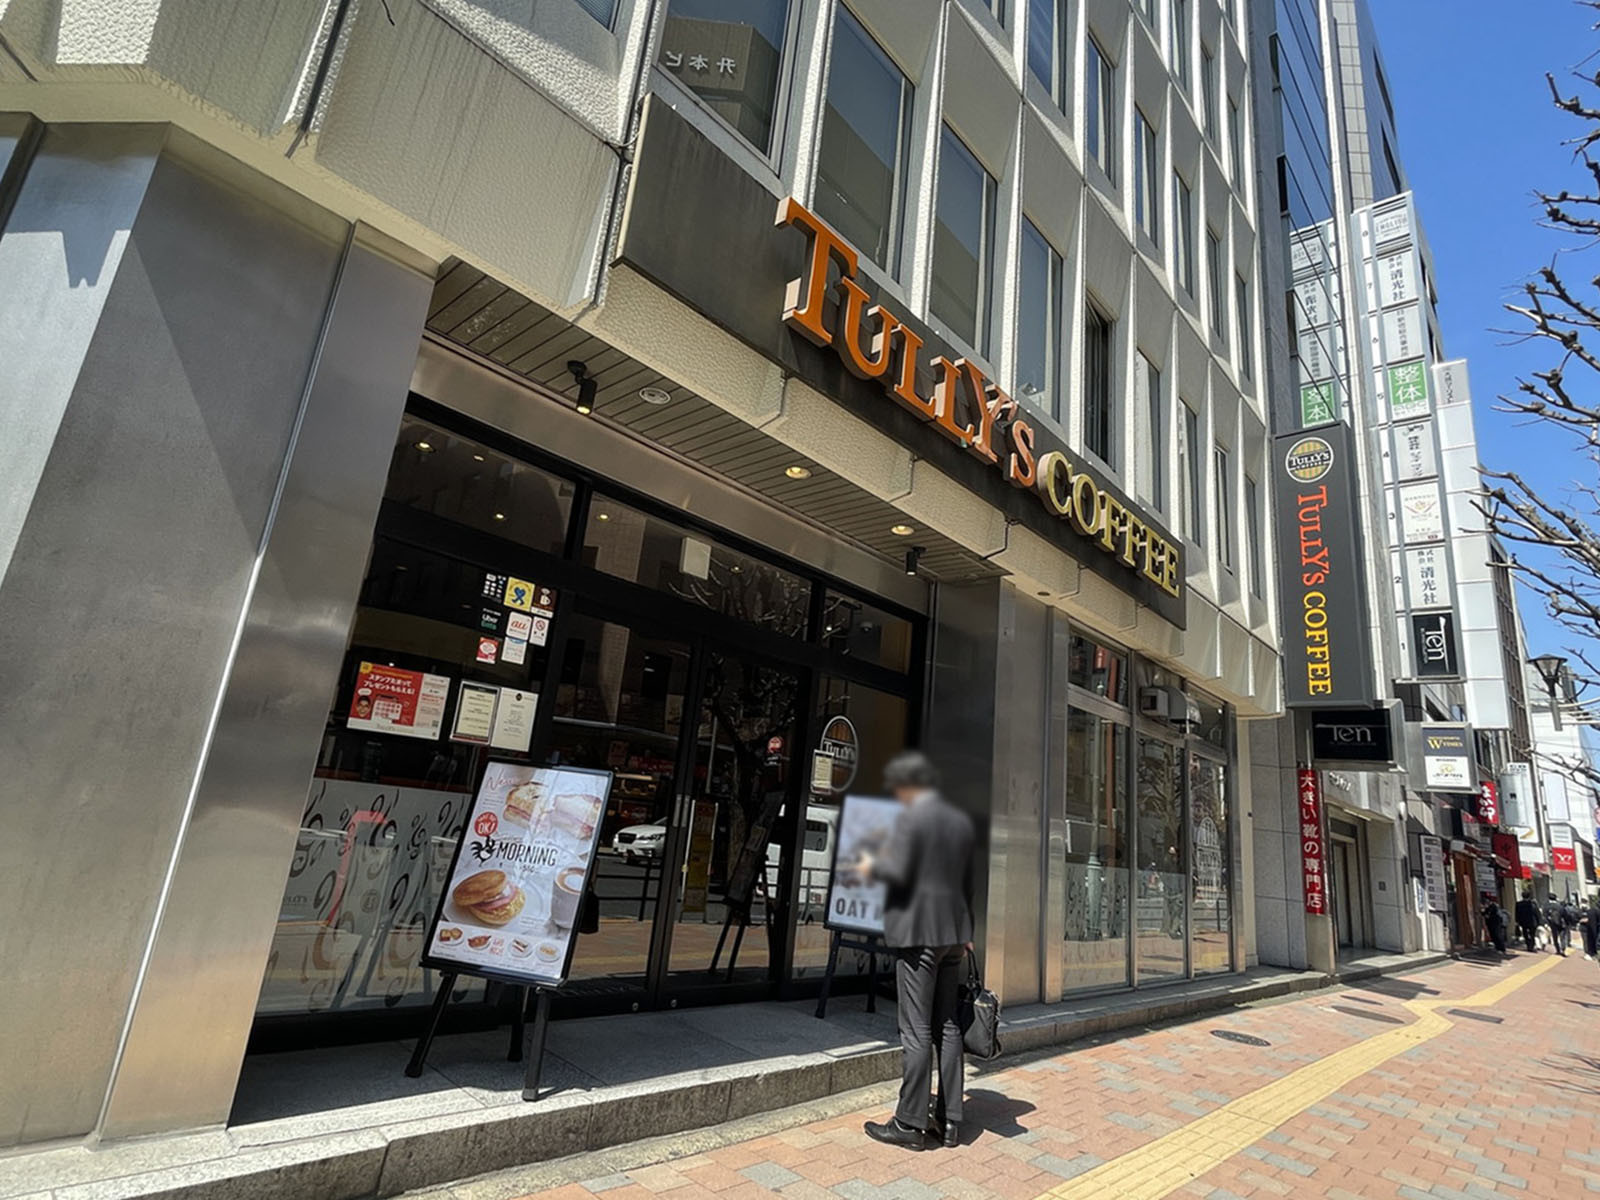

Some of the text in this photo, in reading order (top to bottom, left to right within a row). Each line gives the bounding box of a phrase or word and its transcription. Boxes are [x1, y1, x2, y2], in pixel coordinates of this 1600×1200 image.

[774, 196, 1180, 599] TULLY'S COFFEE
[1394, 366, 1423, 403] 整体
[1289, 452, 1329, 466] TULLY'S
[1298, 486, 1332, 695] TULLY'S COFFEE
[1420, 567, 1438, 605] 清光社
[1425, 617, 1449, 671] Ten
[496, 841, 559, 867] MORNING
[1301, 774, 1323, 909] 大きい靴の専門店
[836, 898, 870, 920] OAT
